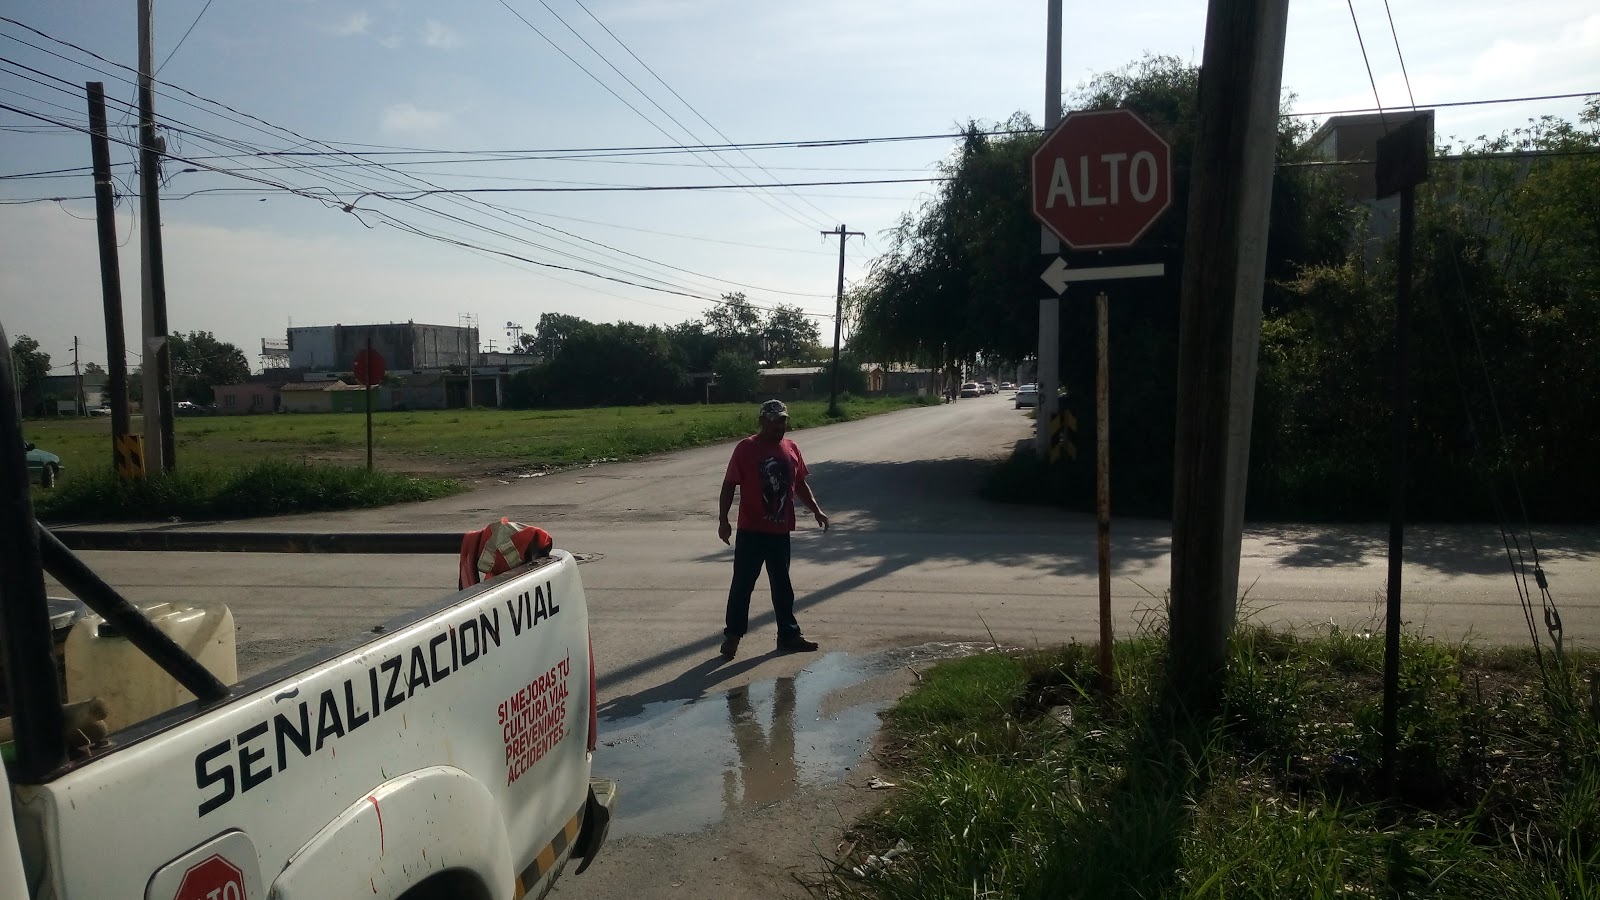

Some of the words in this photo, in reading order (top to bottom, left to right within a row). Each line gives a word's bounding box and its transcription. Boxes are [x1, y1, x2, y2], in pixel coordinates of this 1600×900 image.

[1045, 150, 1158, 209] ALTO
[195, 608, 501, 818] SEÑALIZACION
[506, 580, 560, 637] VIAL
[497, 700, 508, 725] SI
[510, 667, 557, 717] MEJORAS
[557, 657, 570, 681] TU
[503, 696, 549, 744] CULTURA
[549, 680, 569, 708] VIAL
[505, 701, 566, 767] PREVENIMOS
[507, 722, 564, 787] ACCIDENTES
